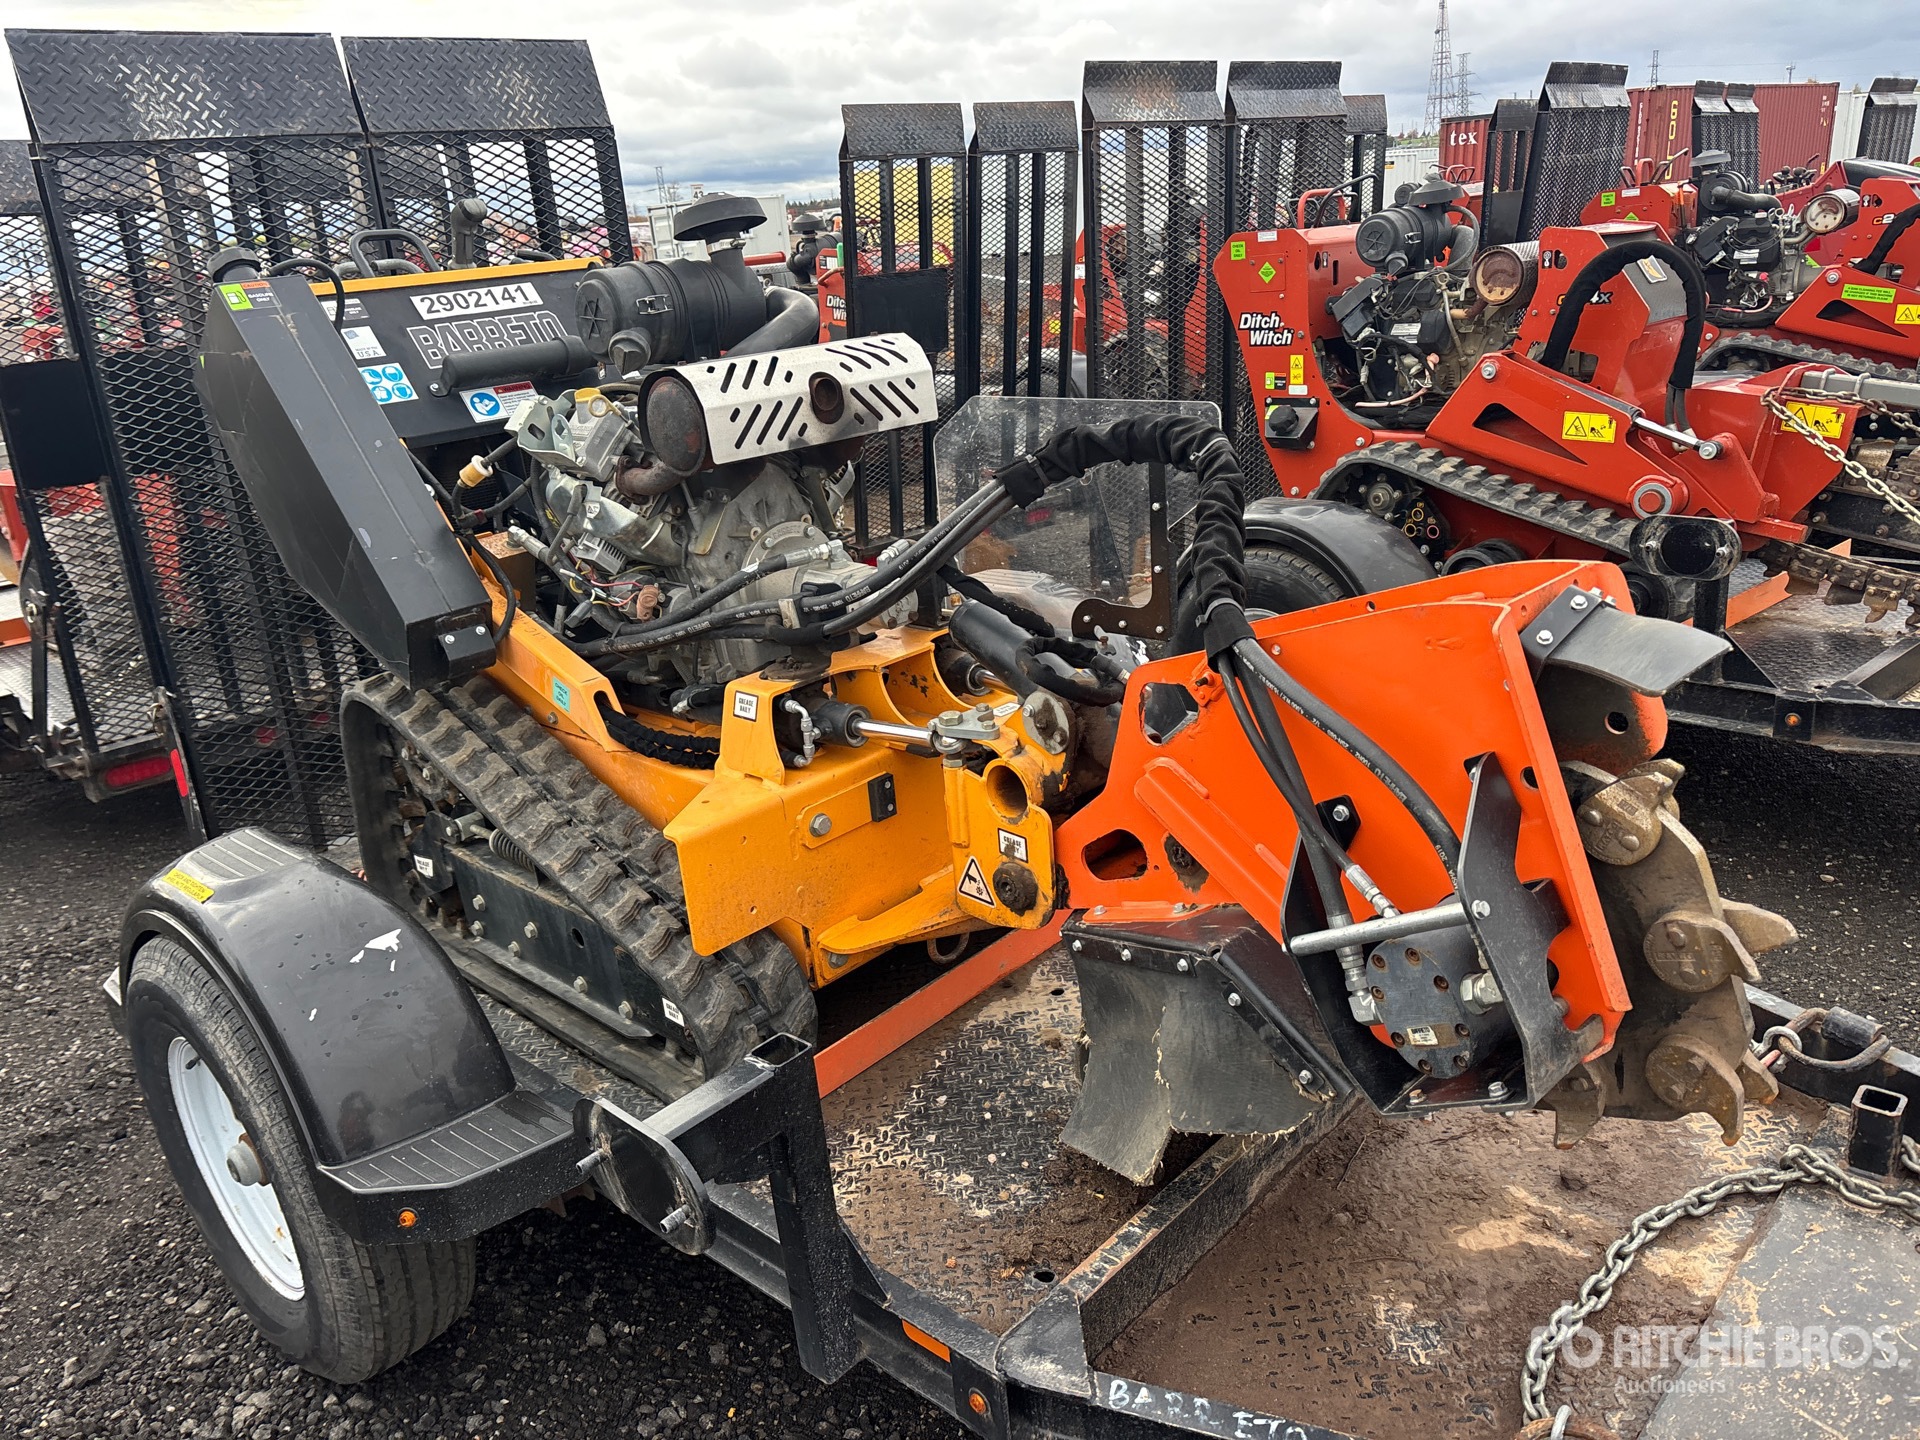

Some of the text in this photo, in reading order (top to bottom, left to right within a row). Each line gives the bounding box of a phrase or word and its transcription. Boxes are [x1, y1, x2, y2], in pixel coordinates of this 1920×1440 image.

[1450, 130, 1478, 146] tex
[419, 285, 529, 314] 2902141
[827, 295, 847, 308] Ditc
[1239, 312, 1280, 329] Ditch
[406, 311, 568, 369] BARRETO
[1250, 329, 1293, 345] Witch
[739, 697, 754, 707] GREASE
